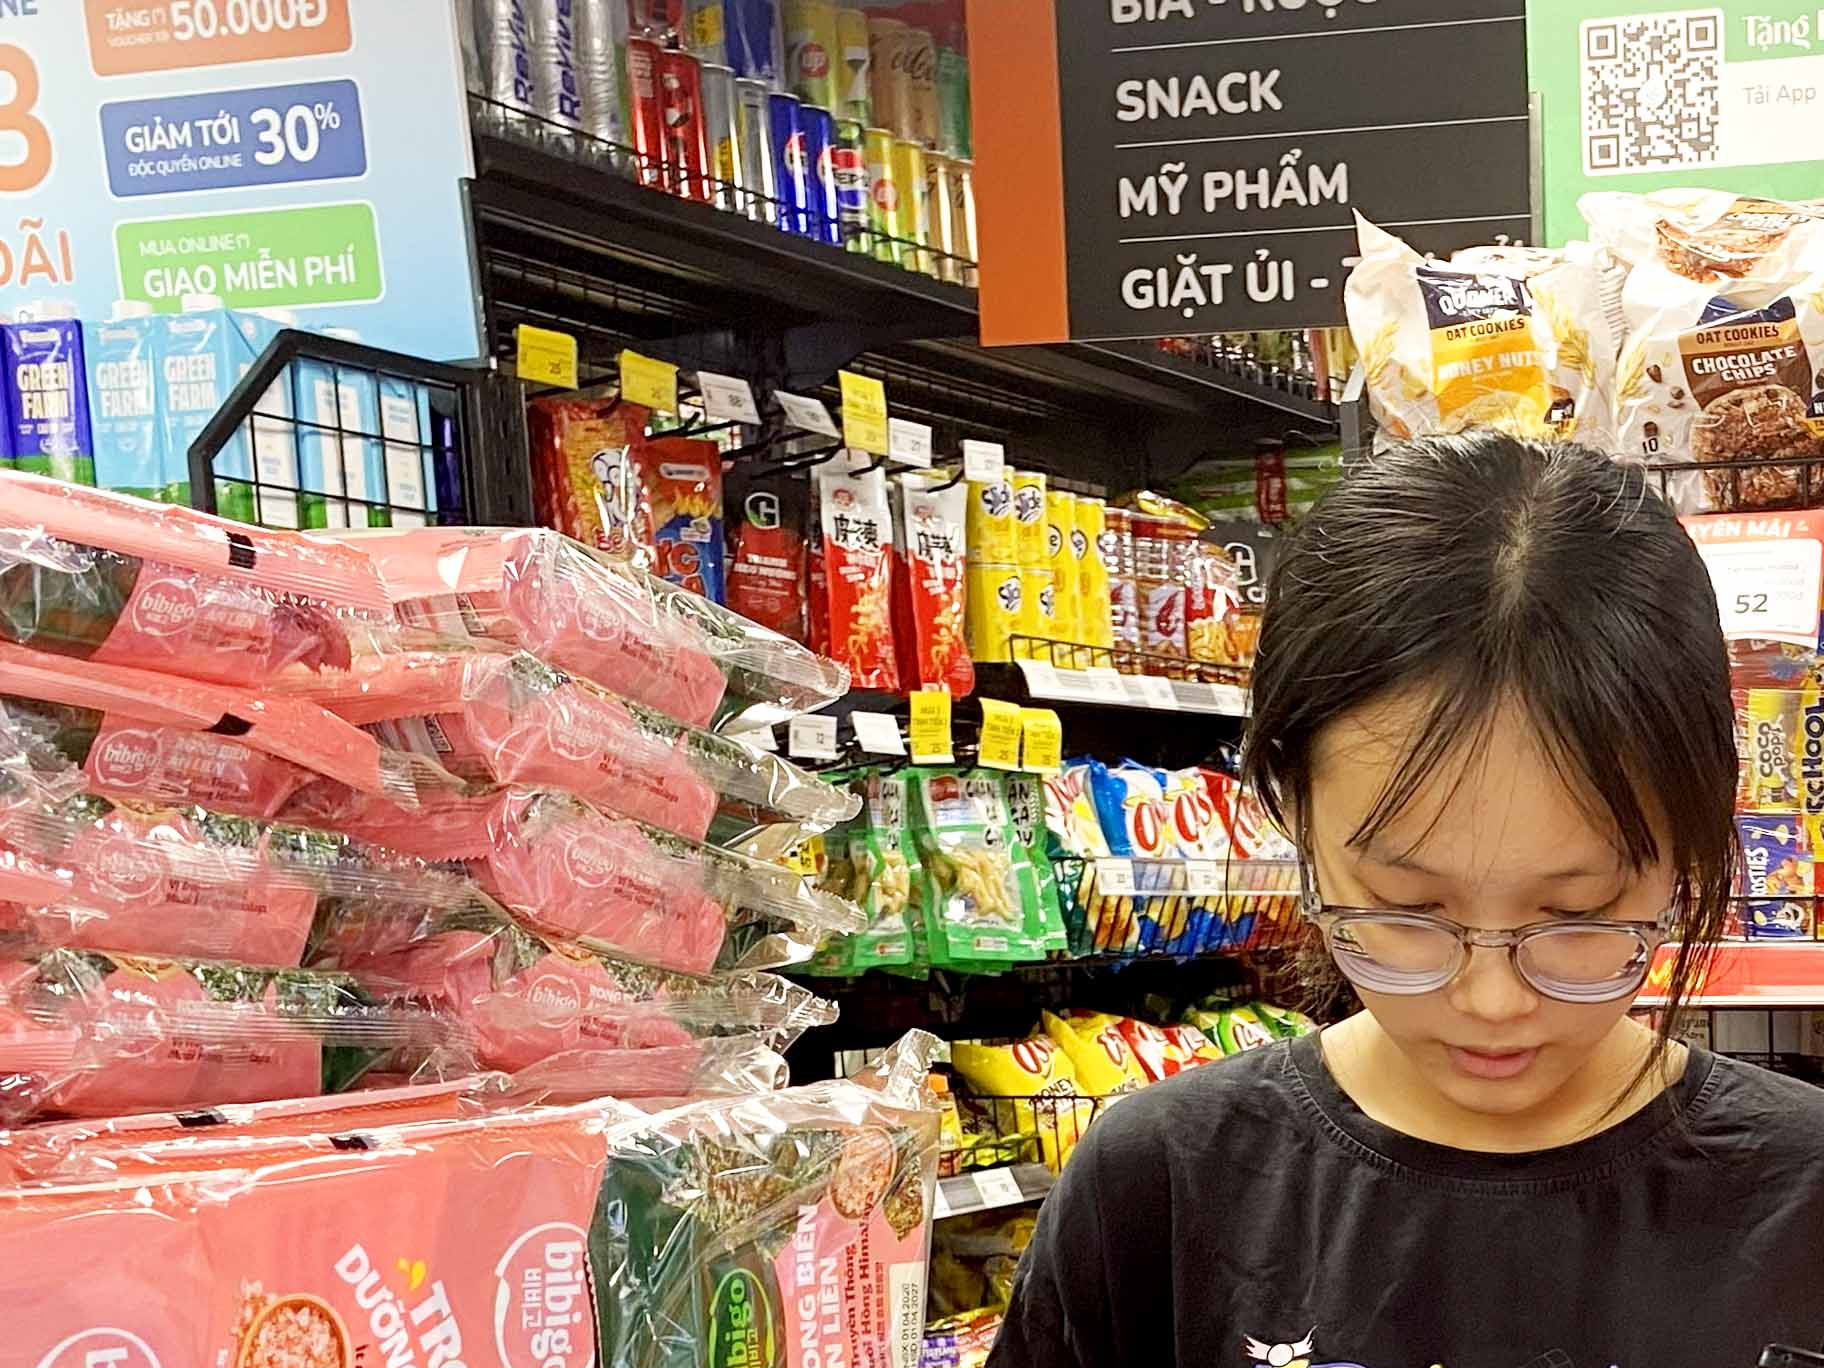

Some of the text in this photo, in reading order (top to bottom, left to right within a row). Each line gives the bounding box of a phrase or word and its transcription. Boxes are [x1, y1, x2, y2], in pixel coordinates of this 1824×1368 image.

[1742, 14, 1811, 51] Tặng
[1115, 67, 1284, 123] SNACK
[1742, 83, 1770, 105] Tải
[1776, 83, 1817, 106] App
[124, 109, 241, 153] GIẢM TỚI
[250, 101, 341, 166] 30%
[199, 152, 243, 172] ONLINE
[1117, 146, 1350, 219] MỸ PHẨM
[138, 238, 179, 258] MUA
[223, 247, 298, 292] MIỄN
[304, 243, 358, 286] PHÍ
[1120, 247, 1296, 319] GIẶT ỦI
[1446, 317, 1526, 342] OAT COOKIES
[1695, 324, 1780, 346] OAT COOKIES
[1691, 344, 1798, 375] CHOCOLATE
[1720, 362, 1778, 383] CHIPS
[1734, 593, 1769, 614] 52
[791, 1202, 819, 1288] BIỂN
[817, 1253, 842, 1336] LIỀN
[860, 1282, 874, 1336] Hồng
